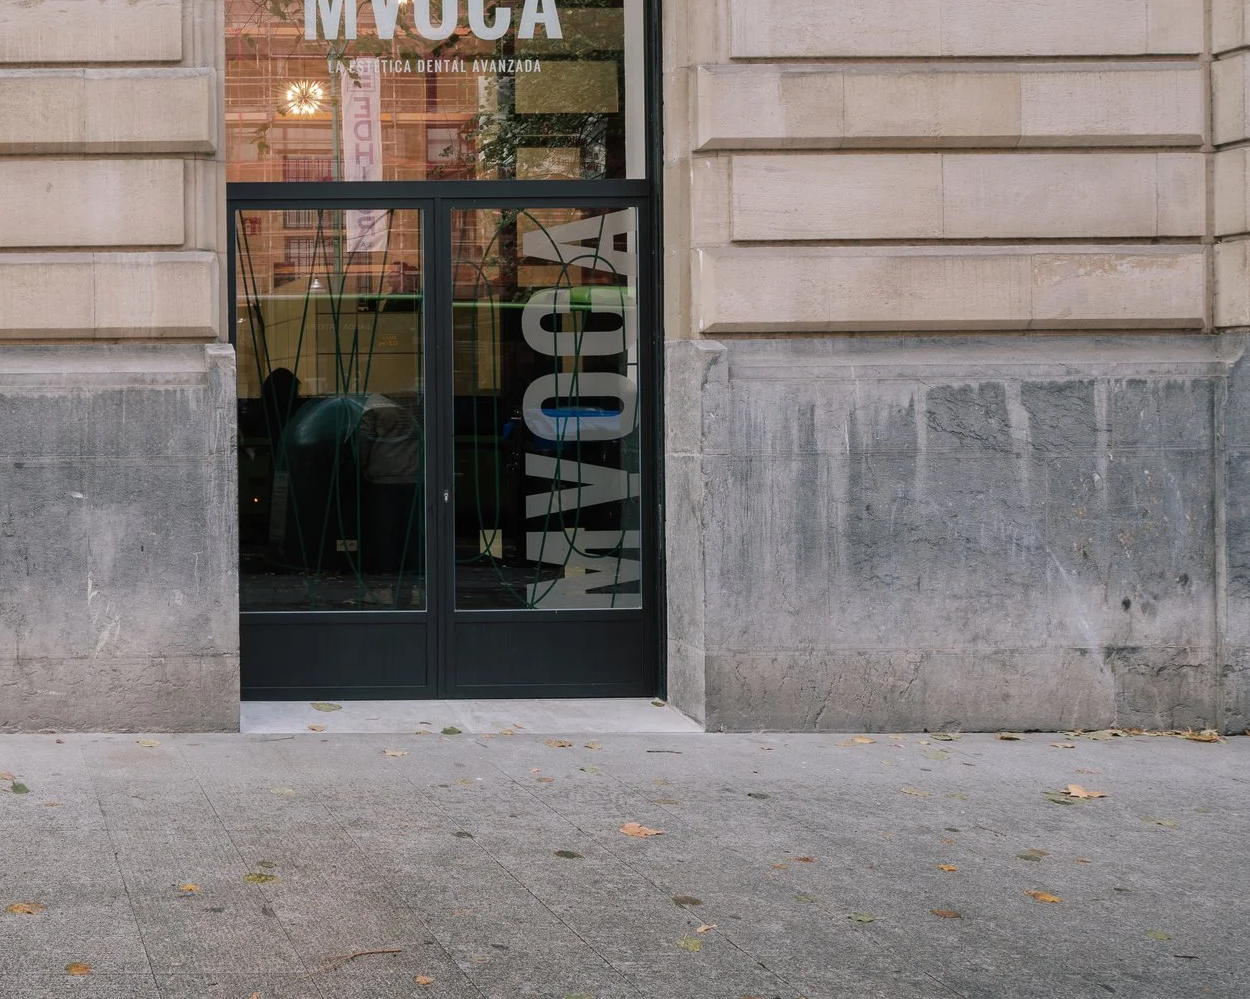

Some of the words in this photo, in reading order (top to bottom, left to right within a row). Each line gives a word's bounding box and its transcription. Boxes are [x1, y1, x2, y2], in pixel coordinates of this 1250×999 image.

[328, 59, 343, 73] LA
[417, 59, 467, 73] DENTAL
[472, 59, 541, 73] AVANZADA
[521, 207, 640, 609] MVOCA
